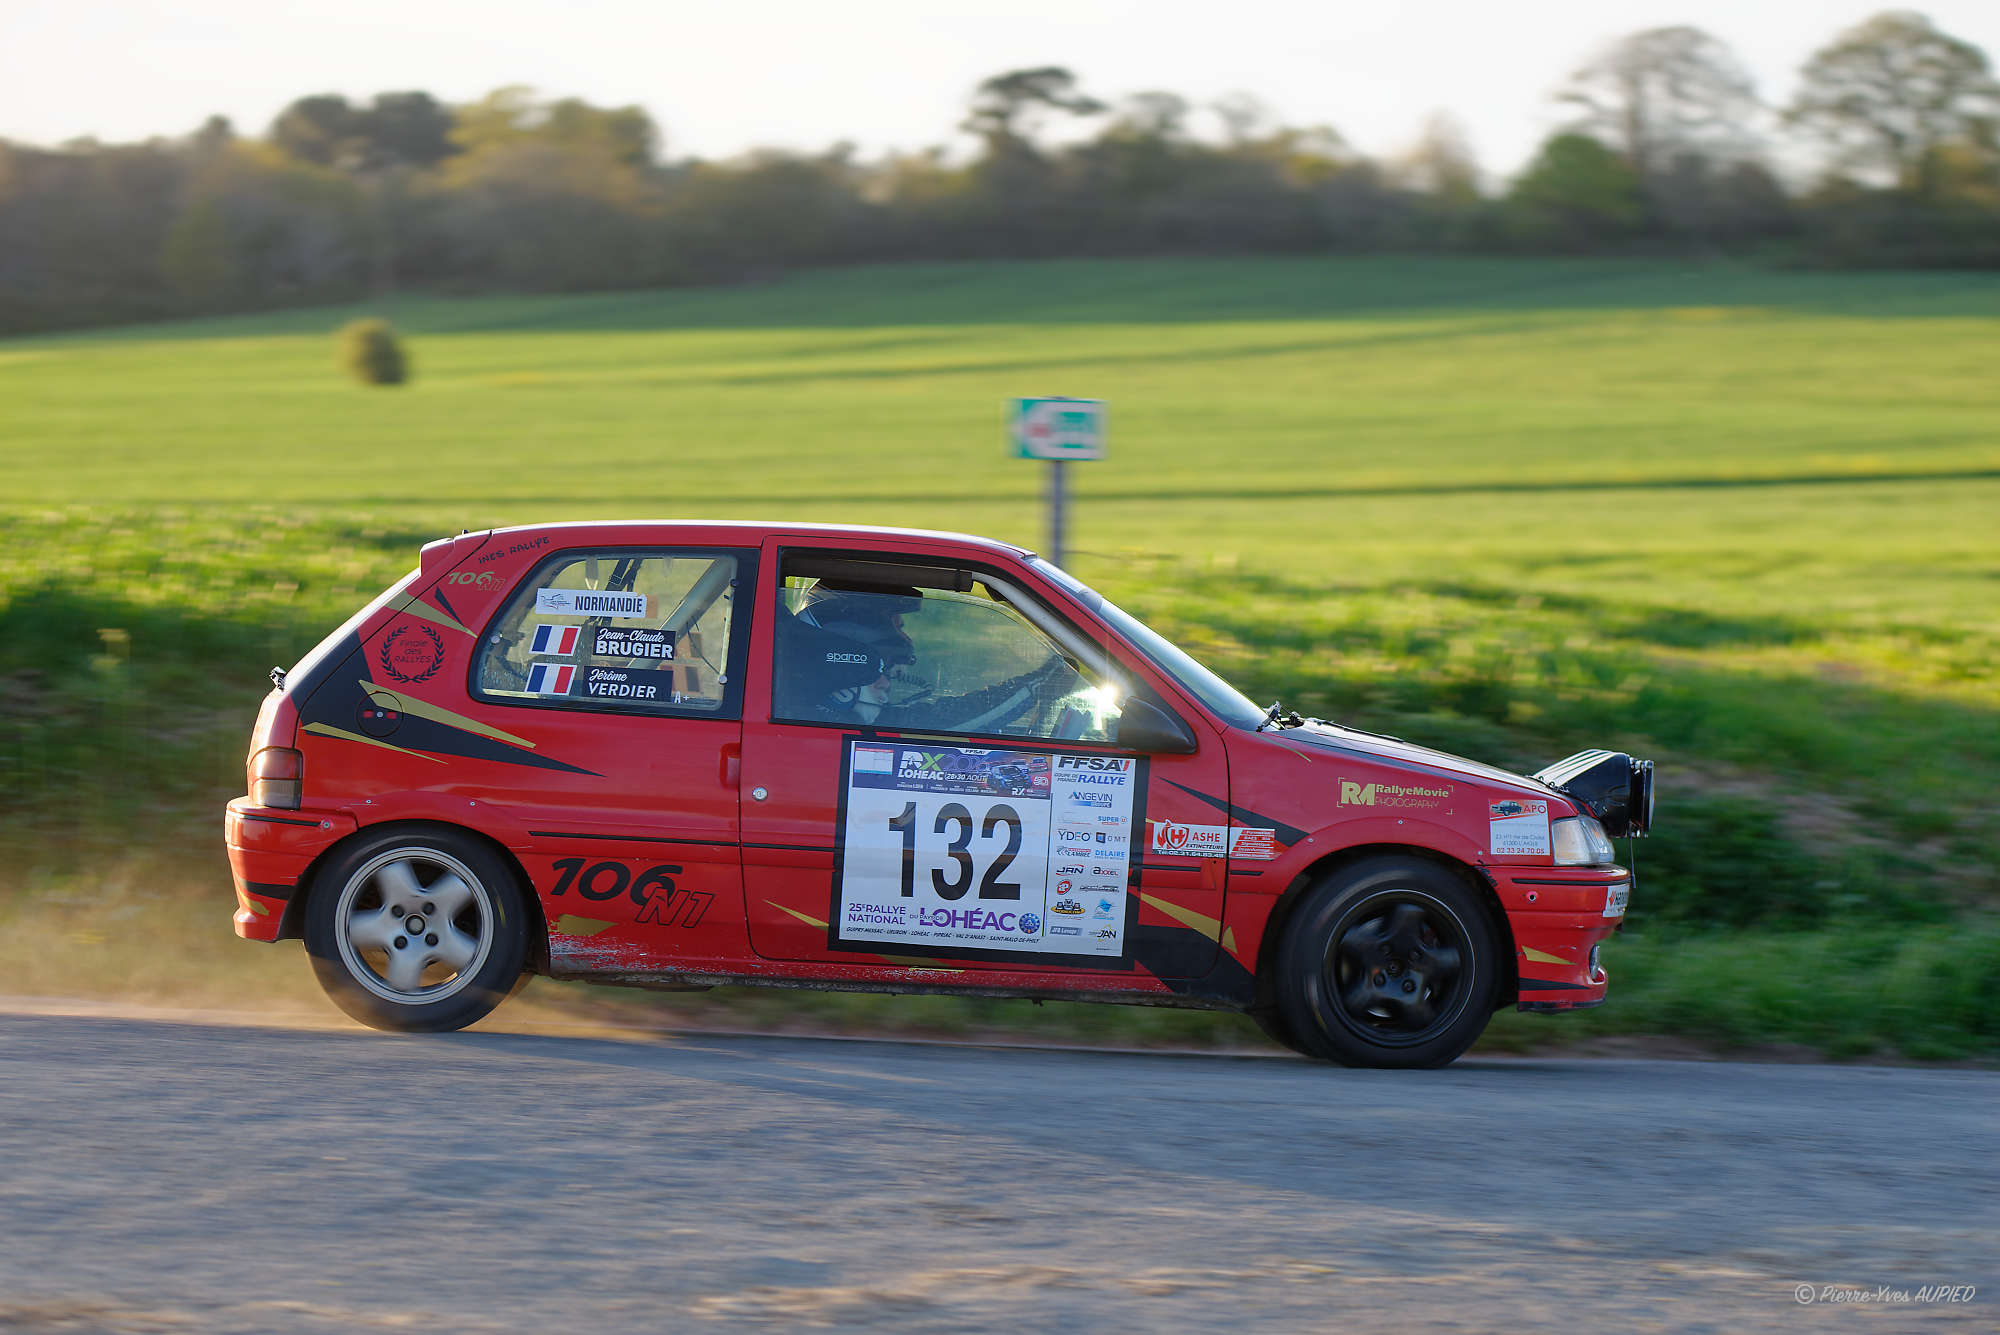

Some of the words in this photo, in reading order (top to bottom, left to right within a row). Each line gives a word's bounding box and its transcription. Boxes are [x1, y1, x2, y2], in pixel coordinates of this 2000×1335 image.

[509, 536, 551, 555] RALLYE
[447, 571, 497, 585] 106
[574, 595, 643, 613] NORMANDIE
[596, 628, 666, 644] Jean-Claude
[595, 640, 674, 659] BRUGIER
[826, 652, 868, 664] sparco
[588, 668, 629, 683] Jérôme
[588, 682, 657, 699] VERDIER
[1058, 756, 1126, 772] FFSA
[897, 768, 945, 781] LOHEAC
[1077, 774, 1126, 786] RALLYE
[1068, 791, 1113, 802] ANGEVIN
[1376, 784, 1449, 798] RallyeMovie
[1376, 797, 1440, 809] PHOTOGRAPHY
[1524, 804, 1546, 814] APO
[1097, 815, 1119, 823] SUPER
[1192, 831, 1221, 843] ASHE
[888, 801, 1024, 901] 132
[1095, 850, 1125, 858] DELAIRE
[550, 858, 683, 906] 106
[634, 887, 715, 928] N1
[866, 904, 906, 915] RALLYE
[848, 913, 906, 925] NATIONAL
[919, 907, 1017, 932] LOHÉAC
